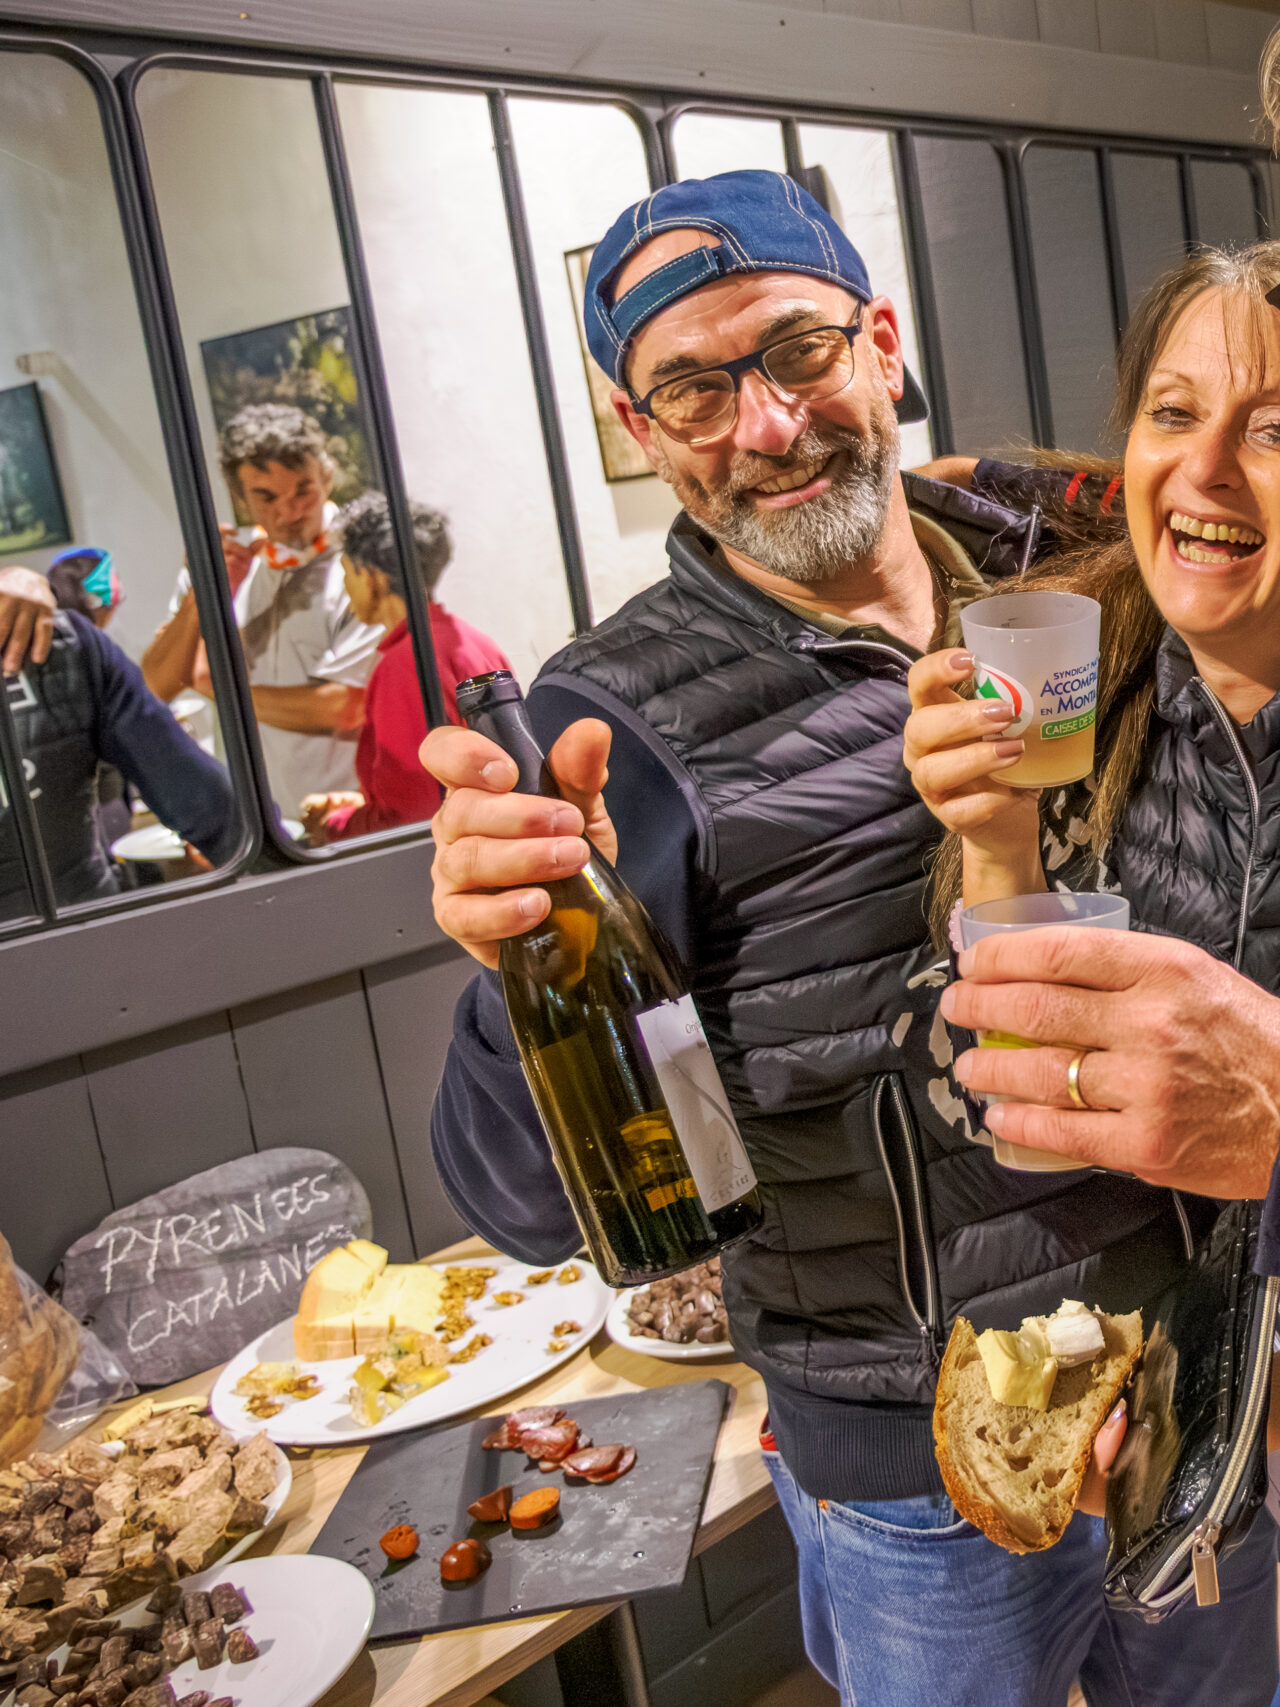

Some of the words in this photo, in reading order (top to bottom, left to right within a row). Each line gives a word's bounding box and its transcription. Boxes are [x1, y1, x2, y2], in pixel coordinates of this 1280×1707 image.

[1053, 664, 1090, 680] SYNDICAT
[1040, 708, 1053, 716] EN
[1045, 721, 1078, 736] CAISSE
